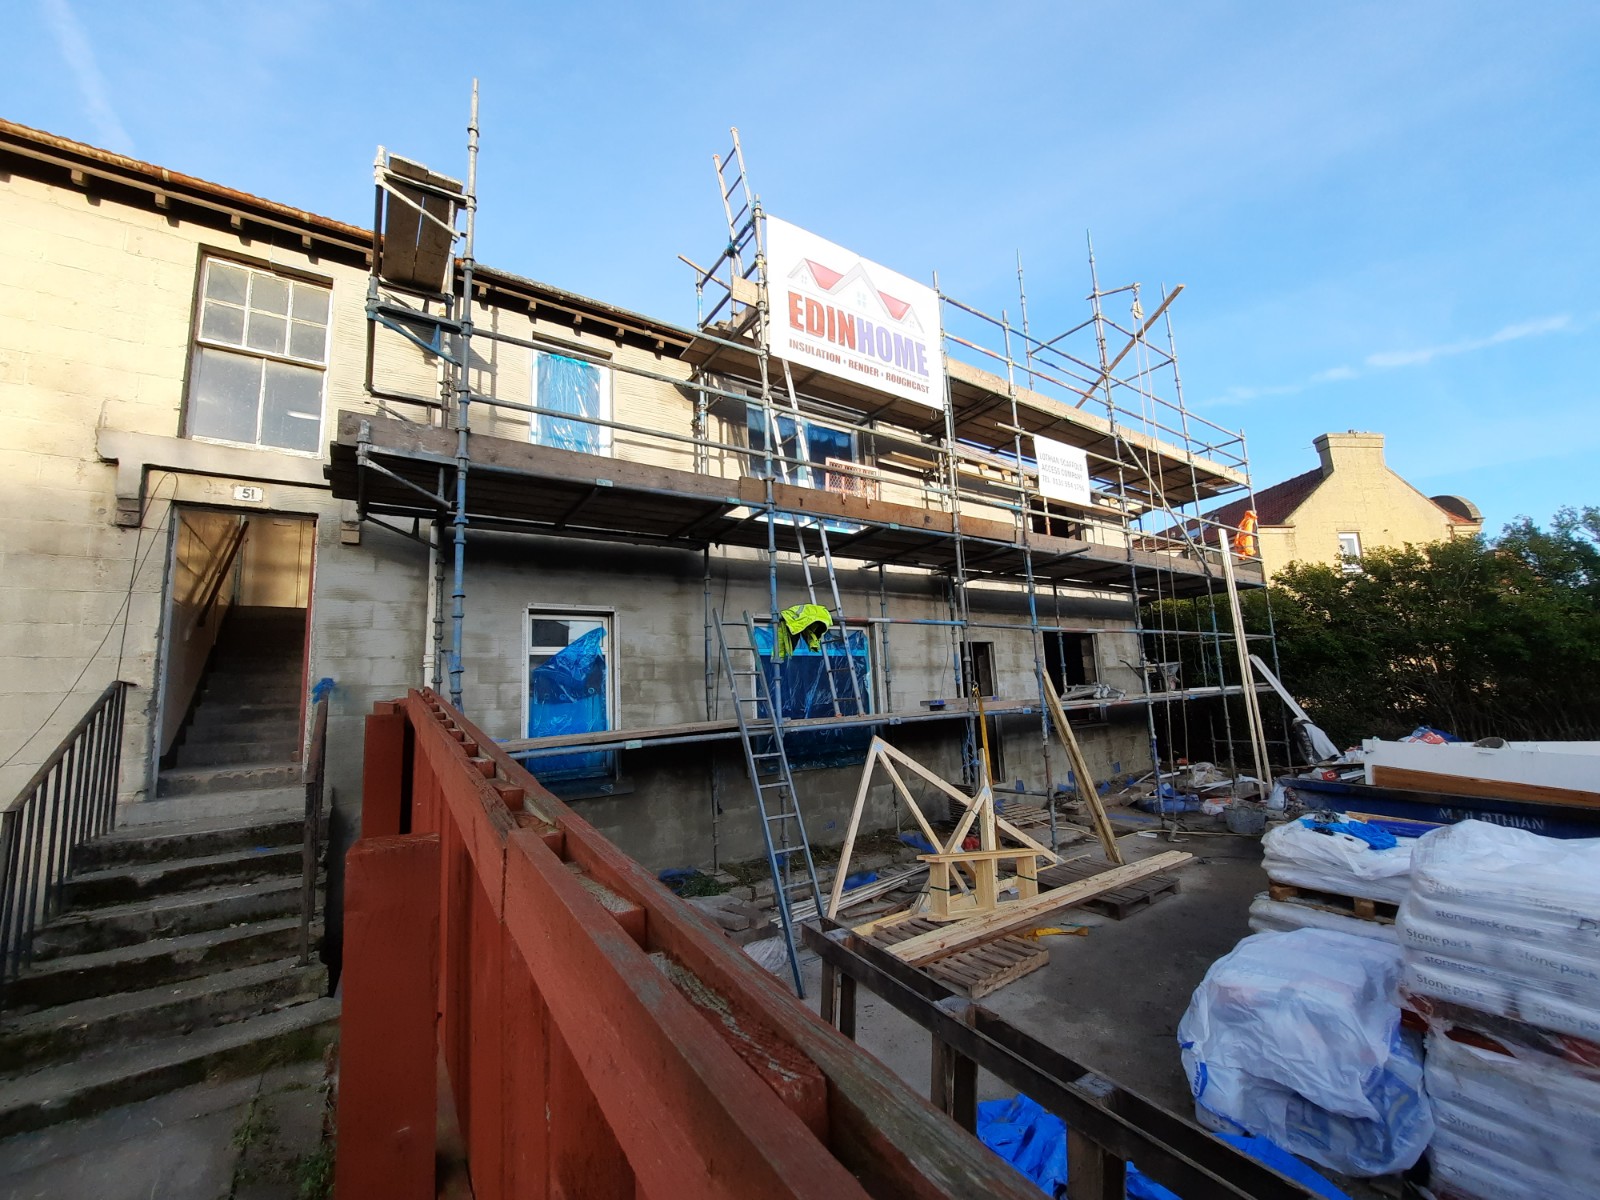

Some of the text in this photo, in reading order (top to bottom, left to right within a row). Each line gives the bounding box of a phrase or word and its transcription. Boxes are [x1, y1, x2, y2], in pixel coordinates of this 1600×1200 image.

[787, 291, 930, 378] EDINHOME
[789, 338, 841, 364] INSULATION
[848, 359, 879, 378] RENDER
[885, 372, 930, 394] ROUGHCAST
[1041, 463, 1083, 480] ACCESS COMPANY
[242, 488, 255, 500] 51
